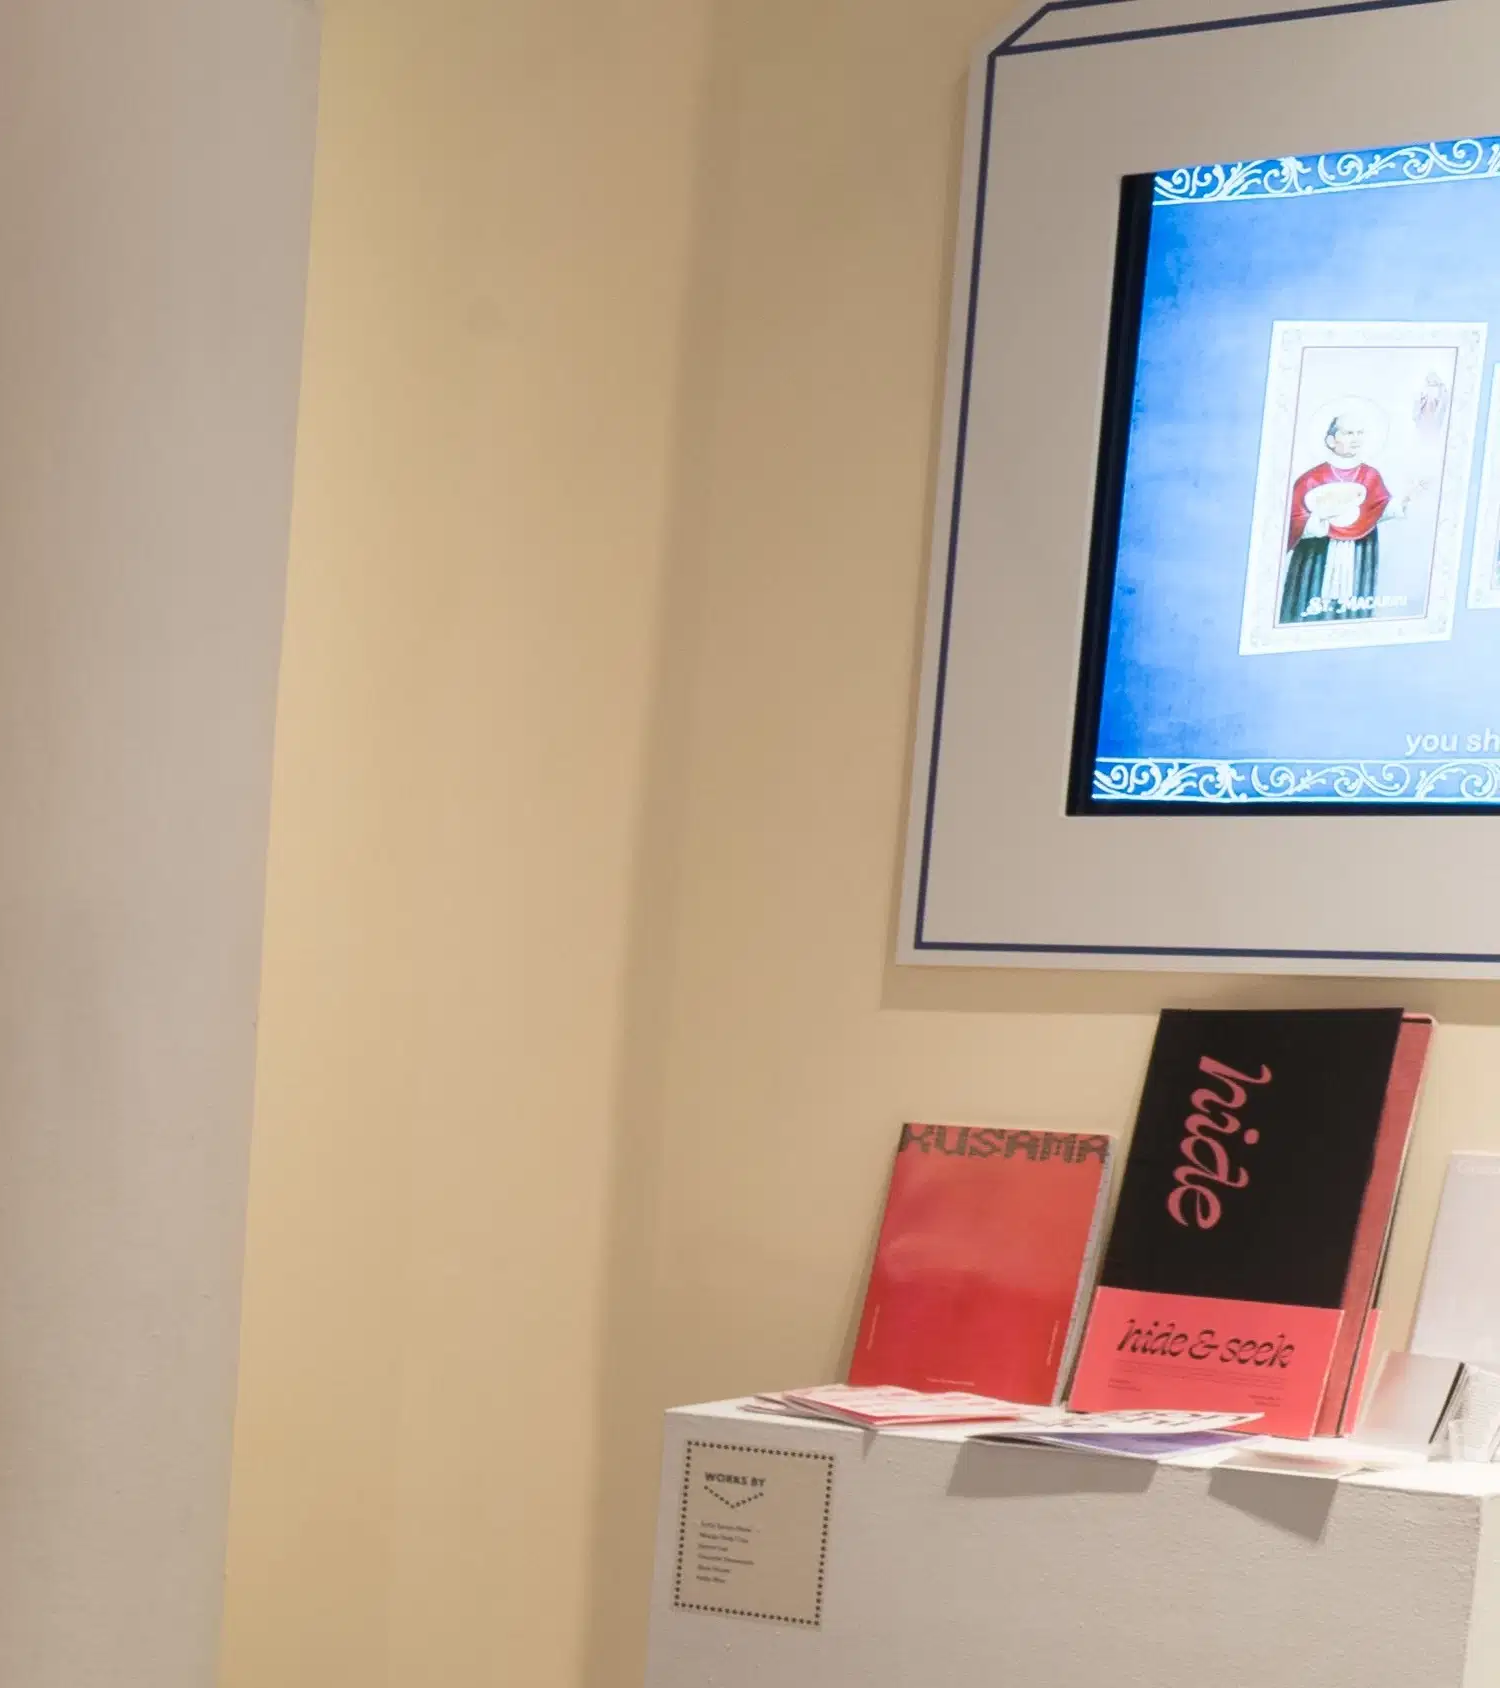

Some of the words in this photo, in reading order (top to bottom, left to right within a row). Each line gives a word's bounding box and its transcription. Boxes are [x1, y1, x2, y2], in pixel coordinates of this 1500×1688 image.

[1404, 731, 1458, 757] you
[1167, 1056, 1273, 1230] hide
[1117, 1319, 1189, 1358] hide
[1188, 1328, 1221, 1360] &
[1219, 1333, 1296, 1370] seek
[704, 1472, 749, 1486] WORKS
[750, 1476, 766, 1487] BY
